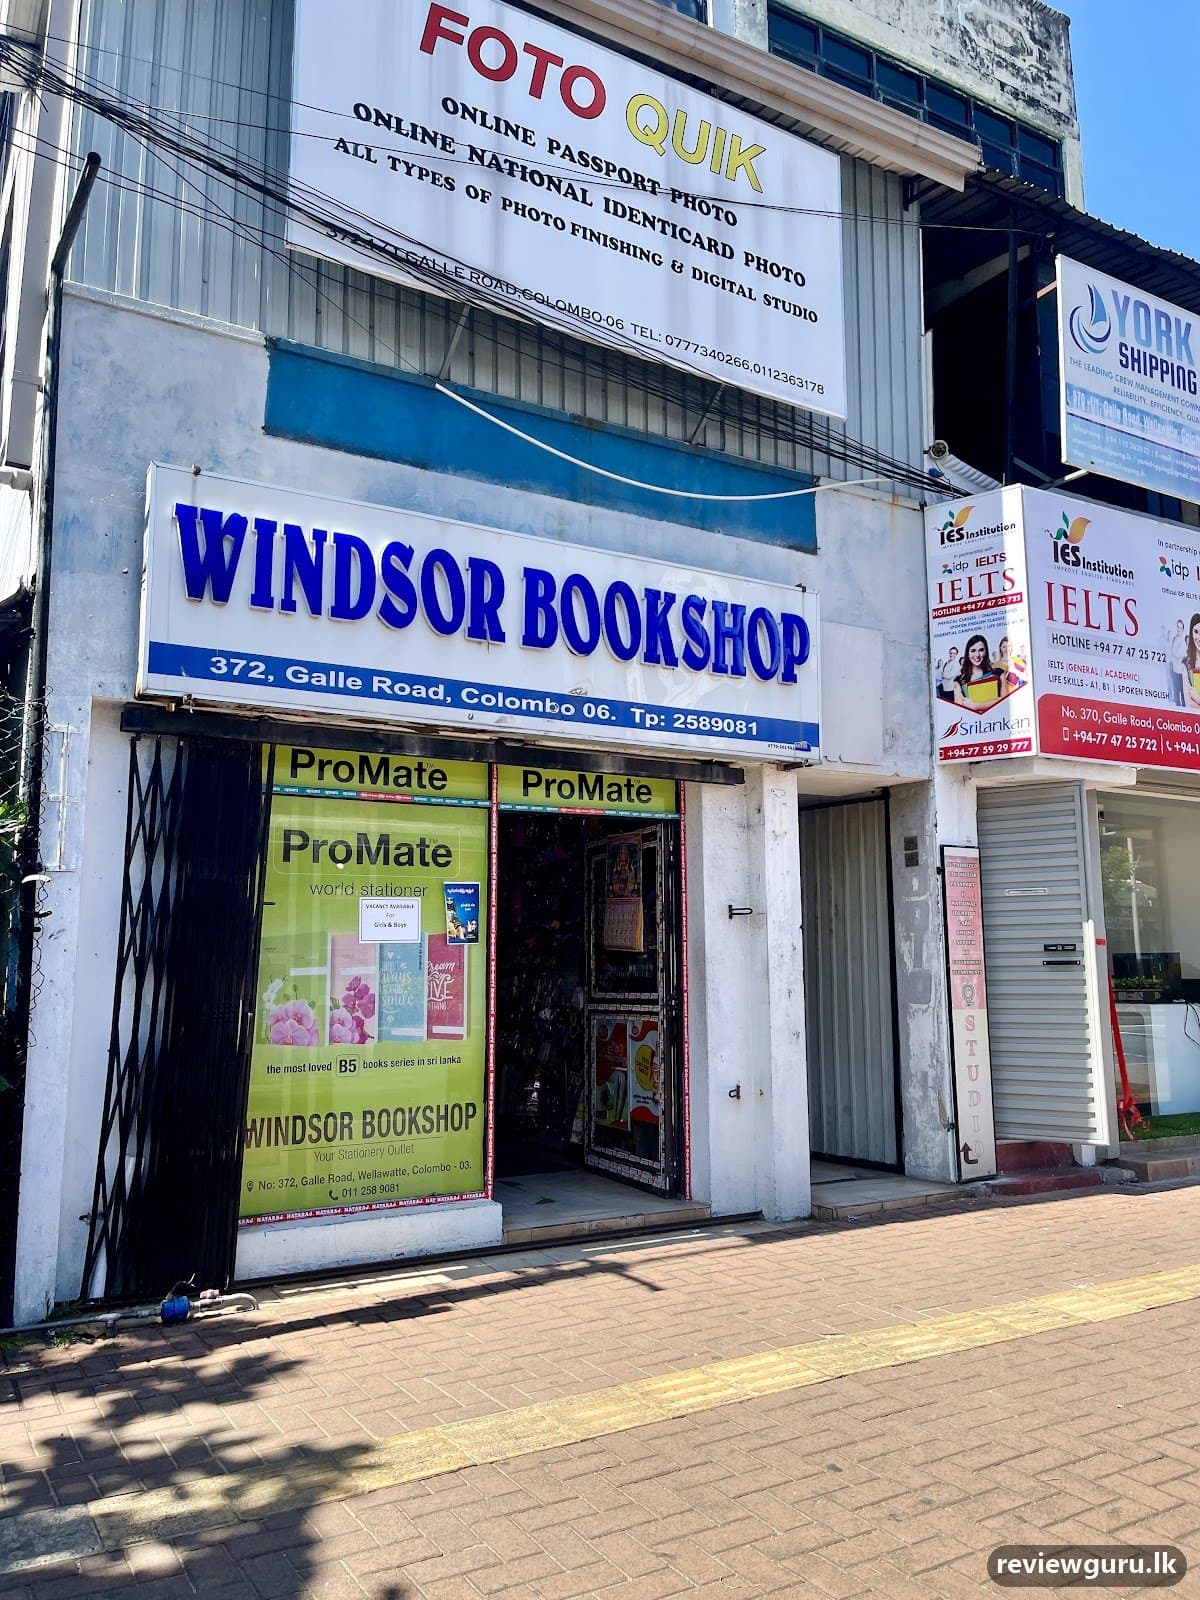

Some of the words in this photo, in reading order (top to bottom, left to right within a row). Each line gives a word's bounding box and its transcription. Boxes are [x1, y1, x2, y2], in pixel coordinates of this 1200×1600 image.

[419, 2, 607, 120] FOTO
[625, 93, 767, 194] QUIK
[441, 96, 536, 147] ONLINE
[547, 137, 661, 196] PASSPORT
[670, 187, 738, 227] PHOTO
[353, 102, 456, 155] ONLINE
[467, 144, 594, 207] NATIONAL
[603, 197, 735, 260] IDENTICARD
[743, 251, 806, 287] PHOTO
[333, 137, 377, 164] ALL
[387, 154, 456, 192] TYPES
[465, 184, 492, 204] OF
[500, 196, 566, 232] PHOTO
[570, 221, 664, 267] FINISHING
[670, 259, 684, 274] &
[691, 266, 757, 301] DIGITAL
[762, 293, 818, 323] STUDIO
[631, 322, 662, 343] TEL:
[1111, 289, 1196, 367] YORK
[1069, 357, 1082, 368] THE
[1083, 362, 1113, 380] LEADING
[1115, 374, 1134, 387] CREW
[1135, 380, 1180, 404] MANAGEMENT
[1118, 342, 1197, 395] SHIPPING
[940, 527, 965, 545] IES
[966, 523, 1016, 540] Institution
[952, 561, 969, 572] idp
[975, 552, 1007, 568] IELTS
[1053, 540, 1081, 567] IES
[1082, 556, 1134, 580] Institution
[1171, 558, 1190, 581] idp
[174, 502, 506, 645] WINDSOR
[521, 567, 811, 685] BOOKSHOP
[936, 567, 1016, 604] IELTS
[932, 606, 961, 617] HOTLINE
[1044, 580, 1139, 636] IELTS
[1051, 632, 1090, 650] HOTLINE
[1093, 641, 1110, 654] +94
[1112, 644, 1123, 655] 77
[1125, 647, 1136, 657] 47
[1138, 649, 1149, 660] 25
[1151, 651, 1168, 663] 722
[1047, 659, 1064, 670] IELTS
[209, 656, 275, 683] 372,
[285, 665, 363, 690] Galle
[372, 676, 452, 704] Road,
[460, 687, 576, 716] Colombo
[582, 702, 617, 720] 06.
[630, 707, 666, 728] Tp:
[672, 712, 758, 736] 2589081
[1048, 674, 1062, 684] LIFE
[1063, 676, 1084, 687] SKILLS
[1118, 684, 1144, 697] SPOKEN
[1144, 687, 1170, 700] ENGLISH
[959, 716, 1031, 736] SriLankan
[1061, 705, 1078, 719] No.
[1080, 707, 1101, 723] 370,
[1103, 711, 1128, 726] Galle
[1130, 714, 1155, 731] Road,
[1156, 718, 1192, 733] Colombo
[947, 746, 979, 758] +94-77
[982, 745, 994, 754] 59
[997, 743, 1009, 753] 29
[1011, 741, 1028, 750] 777
[1072, 730, 1108, 745] +94-77
[1110, 735, 1122, 747] 47
[1125, 736, 1137, 748] 25
[1139, 737, 1157, 751] 722
[289, 748, 448, 791] ProMate
[522, 769, 653, 805] ProMate
[281, 829, 453, 869] ProMate
[309, 882, 354, 896] world
[360, 881, 428, 897] stationer
[267, 1064, 281, 1074] the
[283, 1063, 307, 1074] most
[308, 1062, 332, 1072] loved
[338, 1059, 357, 1073] B5
[362, 1058, 388, 1069] books
[390, 1057, 416, 1068] series
[417, 1056, 425, 1066] in
[426, 1055, 438, 1065] sri
[439, 1055, 462, 1065] lanka
[244, 1111, 353, 1149] WINDSOR
[362, 1102, 477, 1140] BOOKSHOP
[314, 1150, 335, 1163] Your
[338, 1146, 385, 1161] Stationery
[387, 1144, 415, 1156] Outlet
[258, 1180, 276, 1190] No:
[278, 1178, 299, 1189] 372,
[301, 1175, 325, 1187] Galle
[328, 1172, 355, 1185] Road,
[358, 1167, 411, 1181] Wellawatte,
[412, 1163, 451, 1175] Colombo
[459, 1160, 472, 1170] 03.
[342, 1188, 358, 1198] 011
[361, 1186, 377, 1196] 258
[379, 1183, 400, 1194] 9081
